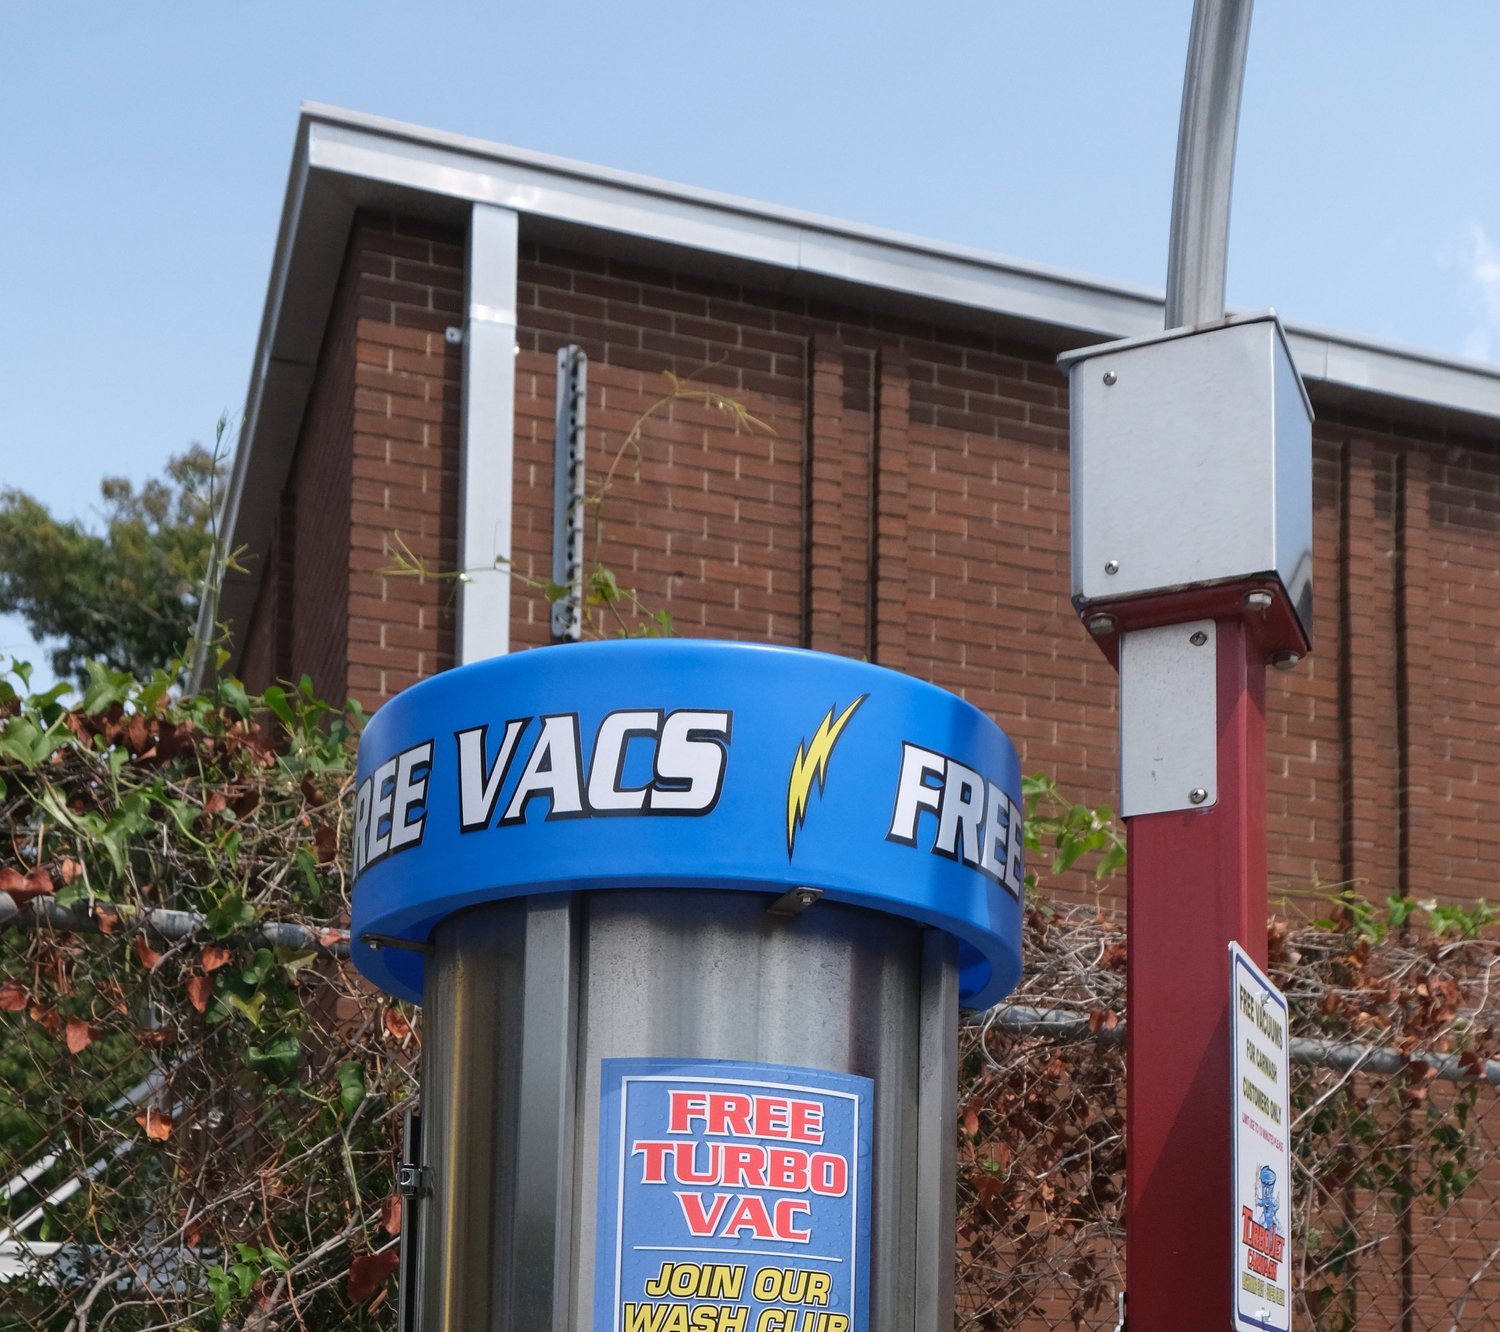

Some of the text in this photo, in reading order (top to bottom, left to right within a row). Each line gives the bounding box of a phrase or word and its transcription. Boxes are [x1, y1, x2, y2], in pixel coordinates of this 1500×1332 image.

[352, 709, 734, 883] REE VACS
[885, 740, 1023, 902] FREE
[1239, 983, 1254, 1023] FREE
[667, 1089, 825, 1145] FREE
[631, 1140, 848, 1197] TURBO
[673, 1191, 811, 1243] VAC
[645, 1262, 832, 1307] JOIN OUR
